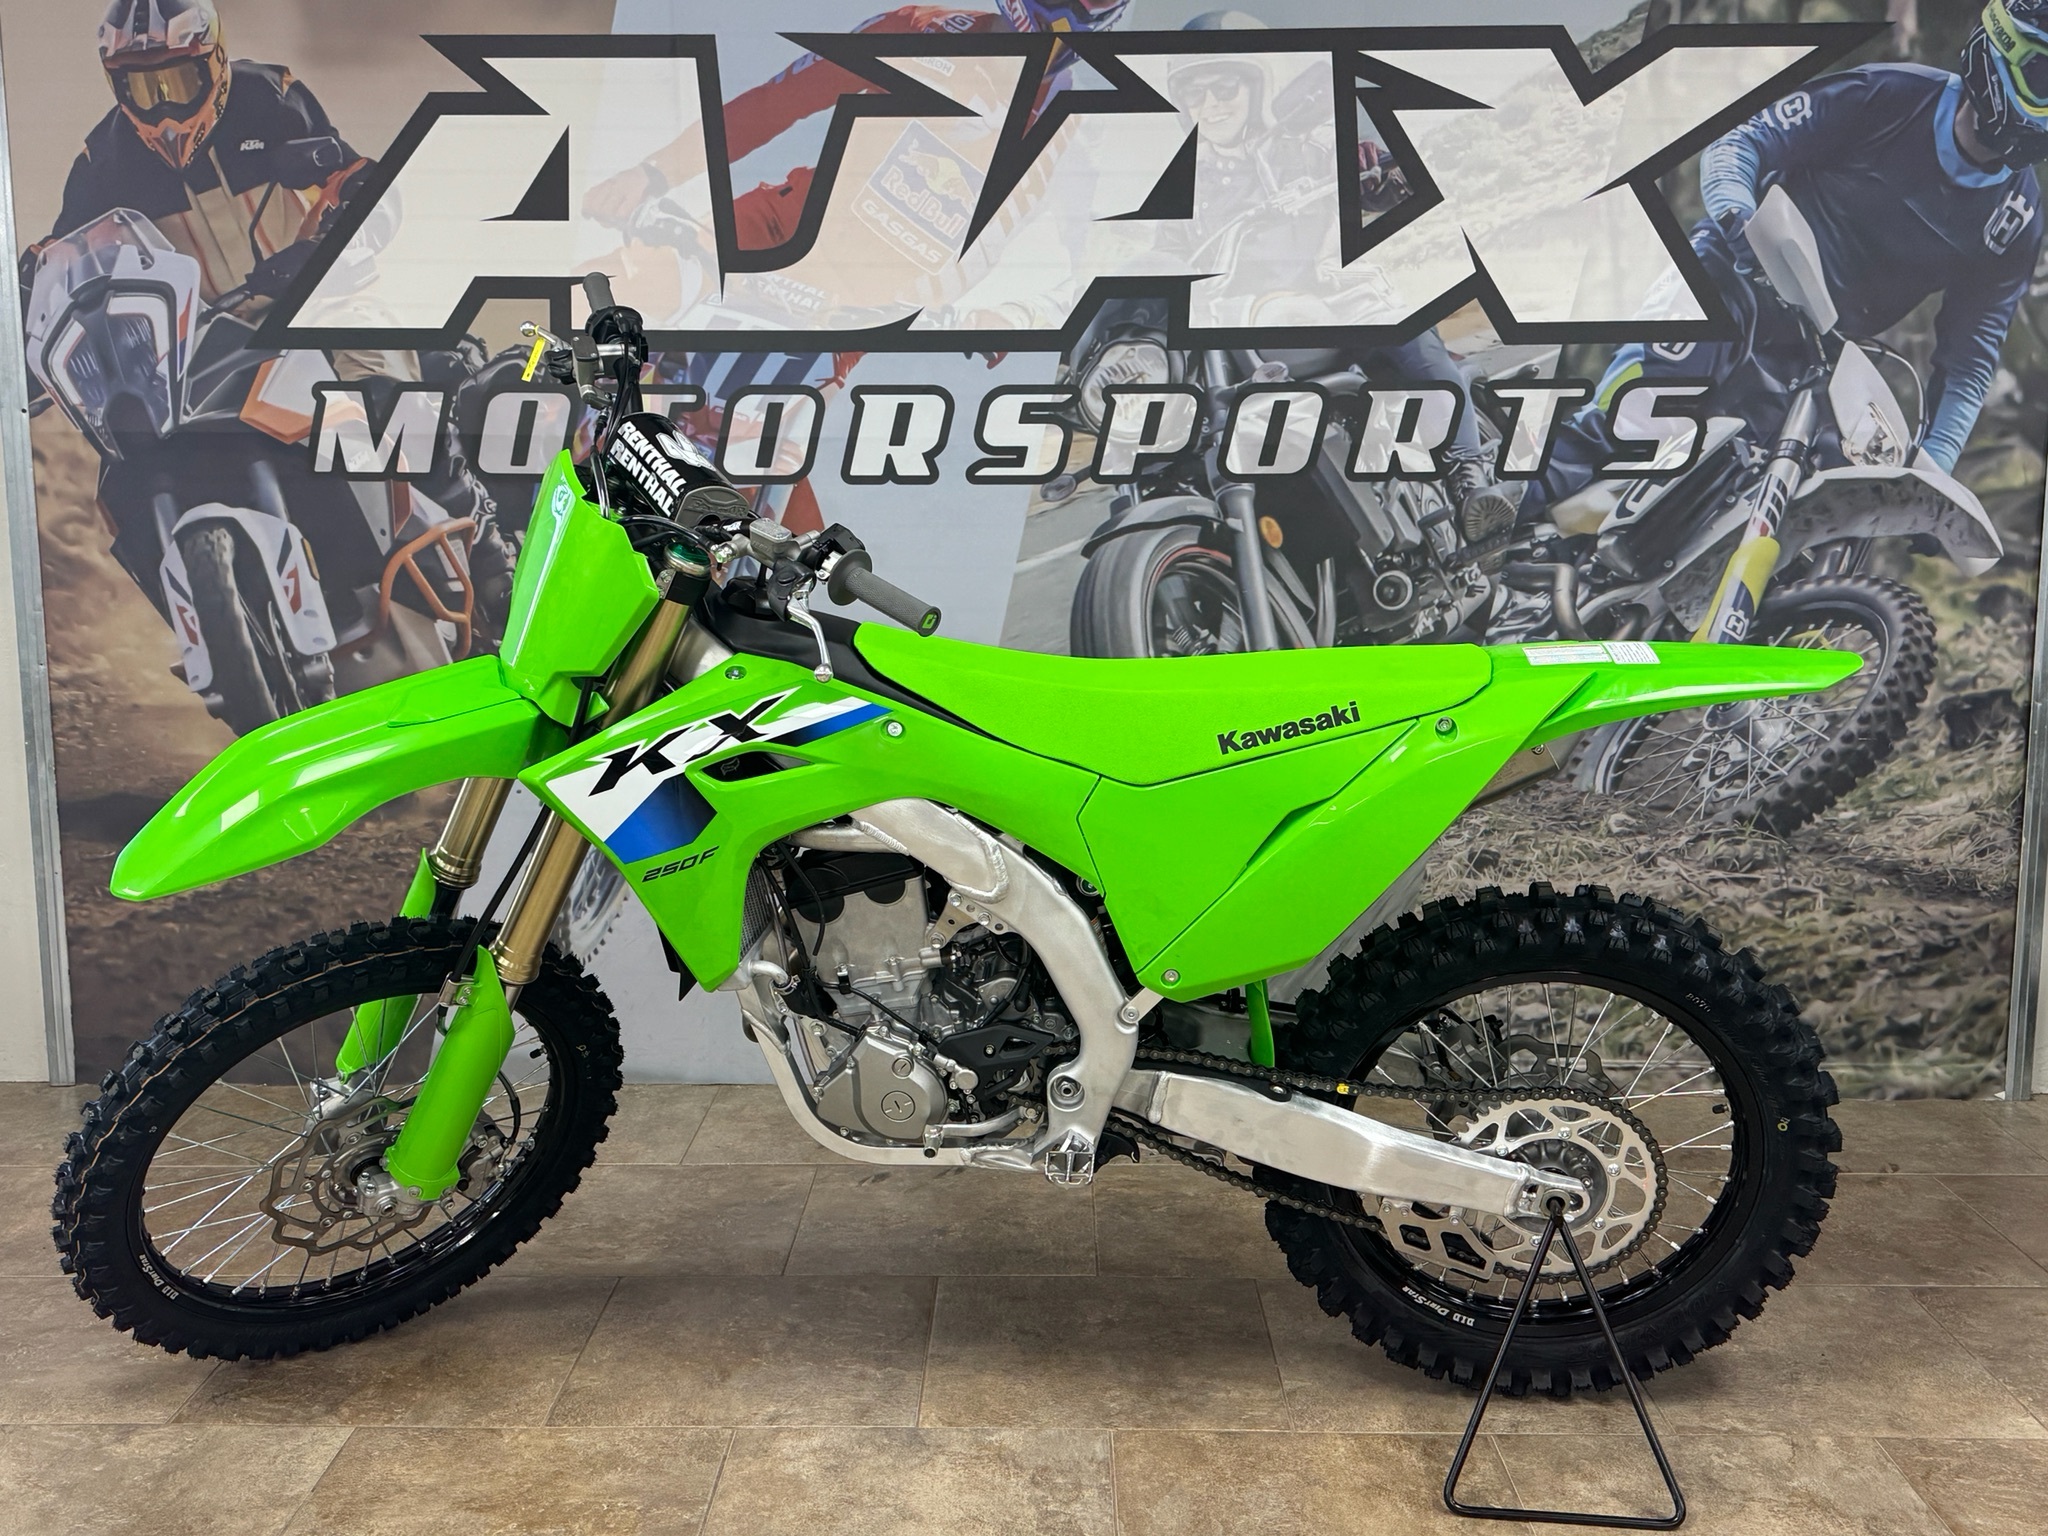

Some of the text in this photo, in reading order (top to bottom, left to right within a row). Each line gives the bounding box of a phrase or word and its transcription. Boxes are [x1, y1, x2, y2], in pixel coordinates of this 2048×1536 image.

[240, 139, 265, 151] KTM
[268, 28, 1865, 348] AJAX
[861, 199, 944, 264] GASGAS
[609, 438, 675, 518] RENTHAL
[617, 420, 688, 498] RENTHAL
[587, 692, 795, 797] KX
[1216, 700, 1361, 756] Kawasaki
[641, 845, 720, 883] 250F
